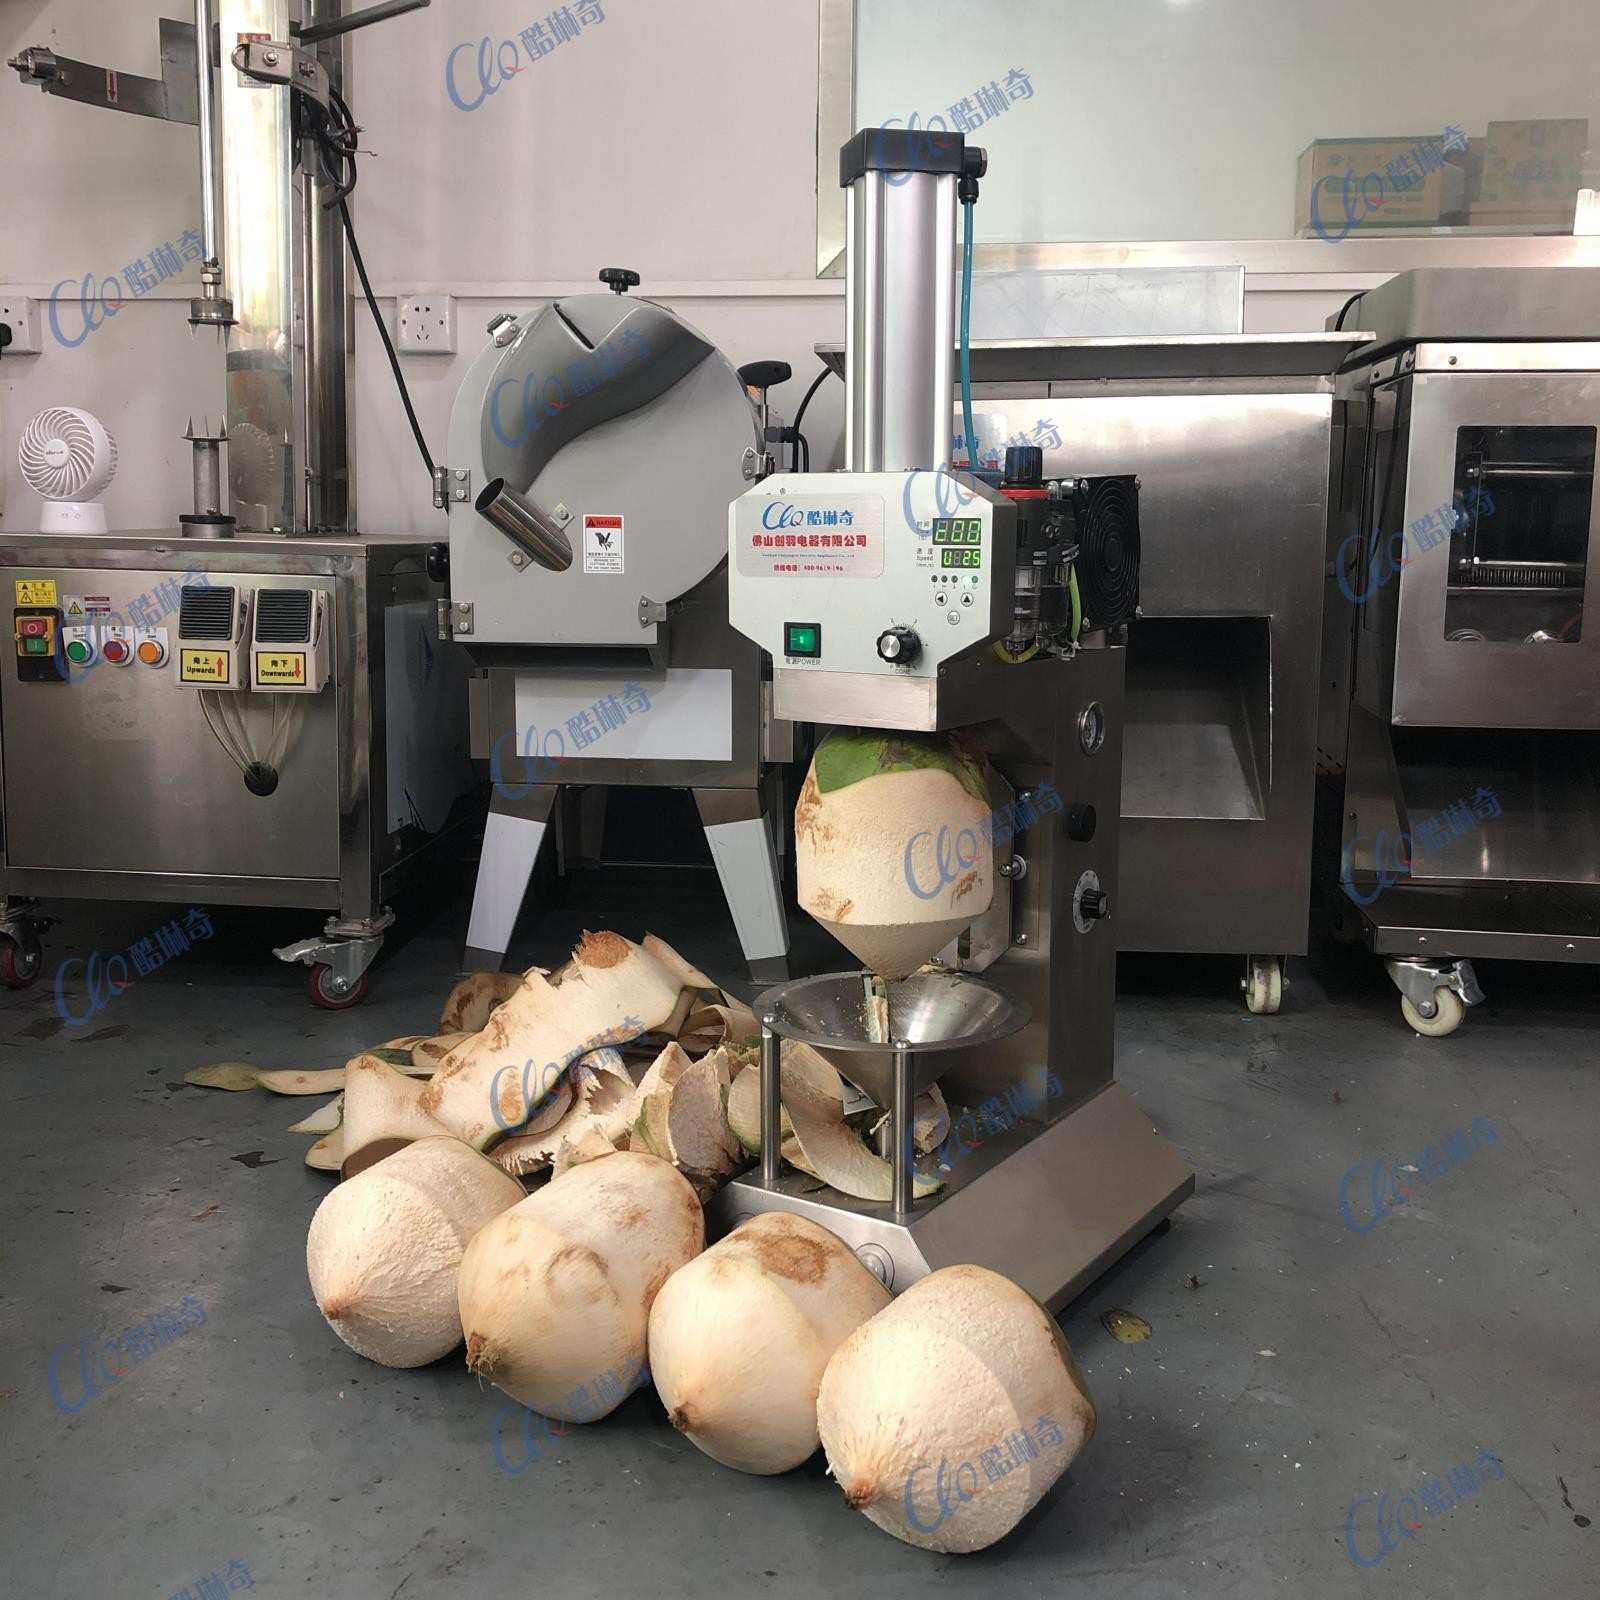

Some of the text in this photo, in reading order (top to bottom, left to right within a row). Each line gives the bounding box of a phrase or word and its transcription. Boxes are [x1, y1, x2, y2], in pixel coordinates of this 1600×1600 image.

[807, 510, 853, 526] 酷琳奇
[752, 535, 867, 547] 佛山创羽电器有限公司
[193, 656, 210, 665] 向上
[186, 666, 216, 675] Upwards
[261, 669, 295, 677] Downwards
